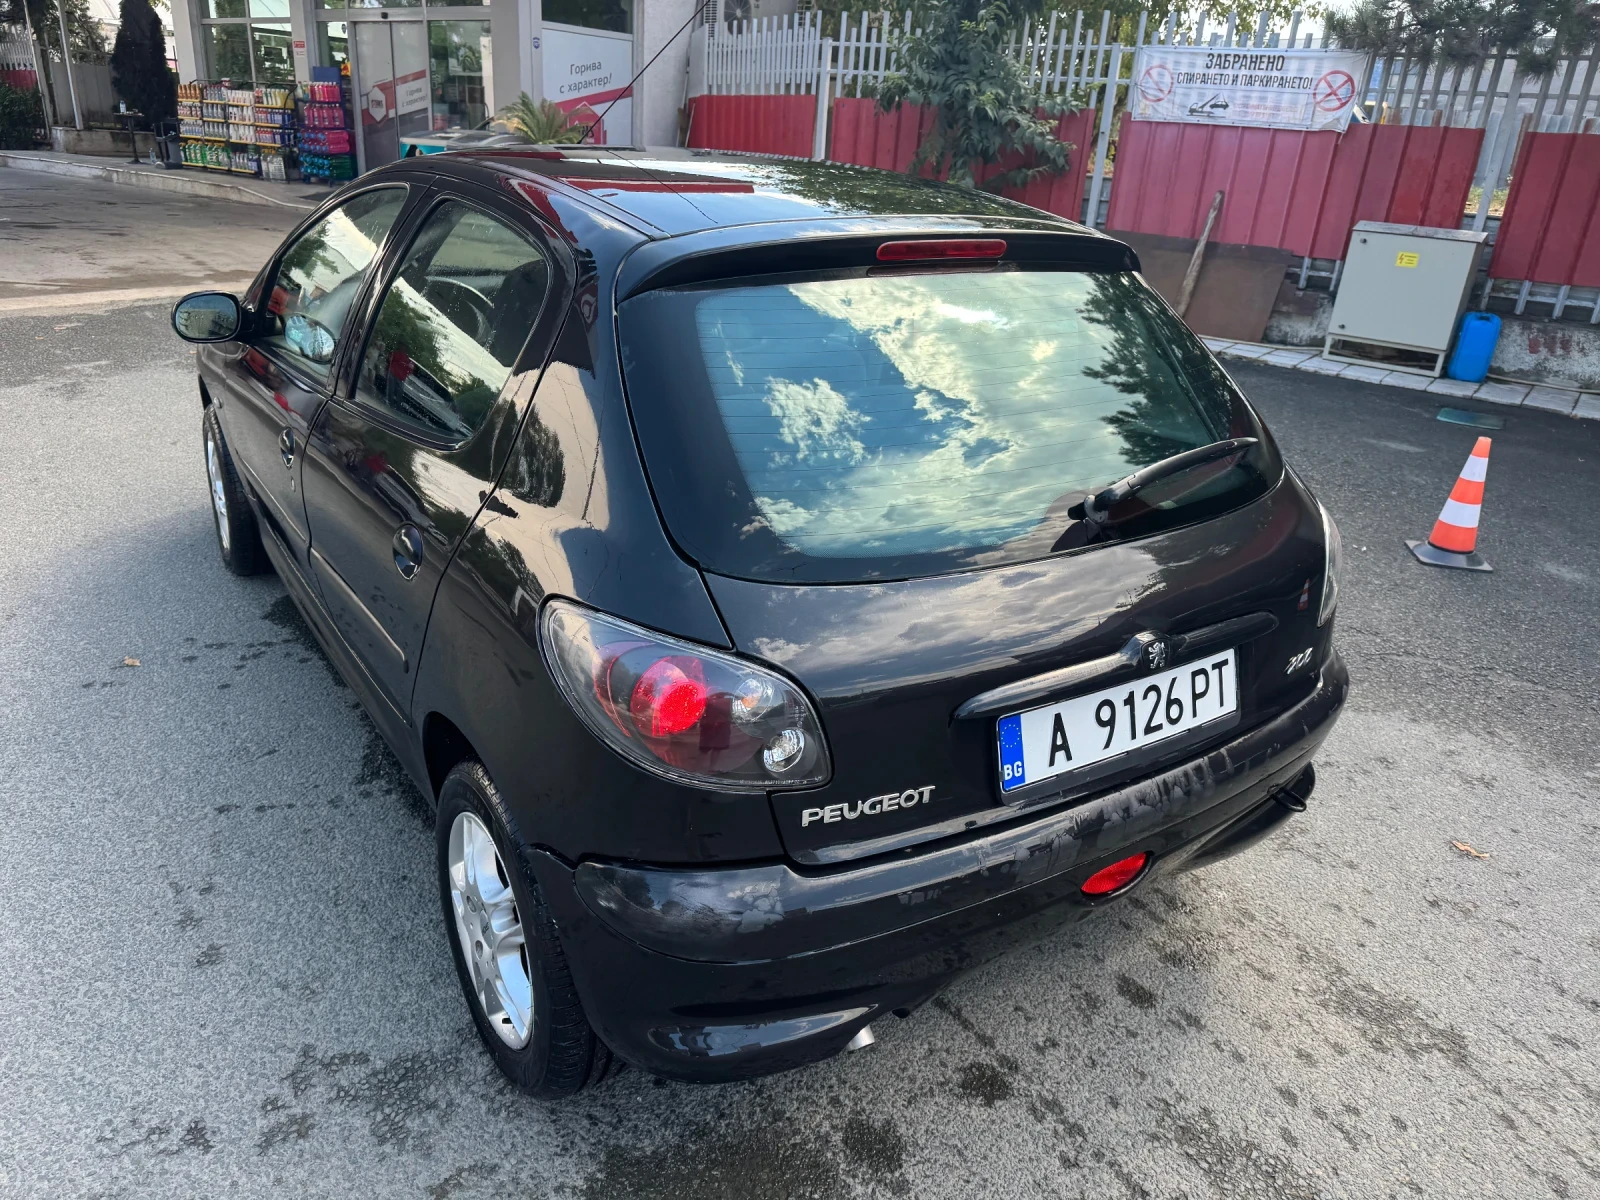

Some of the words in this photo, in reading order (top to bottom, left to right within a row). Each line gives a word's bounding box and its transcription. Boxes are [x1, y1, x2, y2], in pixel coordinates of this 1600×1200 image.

[570, 61, 602, 76] Горива
[1205, 53, 1285, 71] ЗАБРАНЕНО
[559, 85, 565, 94] с
[567, 72, 613, 93] характер!
[1176, 72, 1230, 86] СПИРАНЕТО
[1231, 74, 1239, 86] И
[1240, 74, 1313, 90] ПАРКИРАНЕТО!
[1048, 712, 1073, 768] A
[1003, 760, 1023, 781] BG
[801, 785, 936, 828] PEUGEOT
